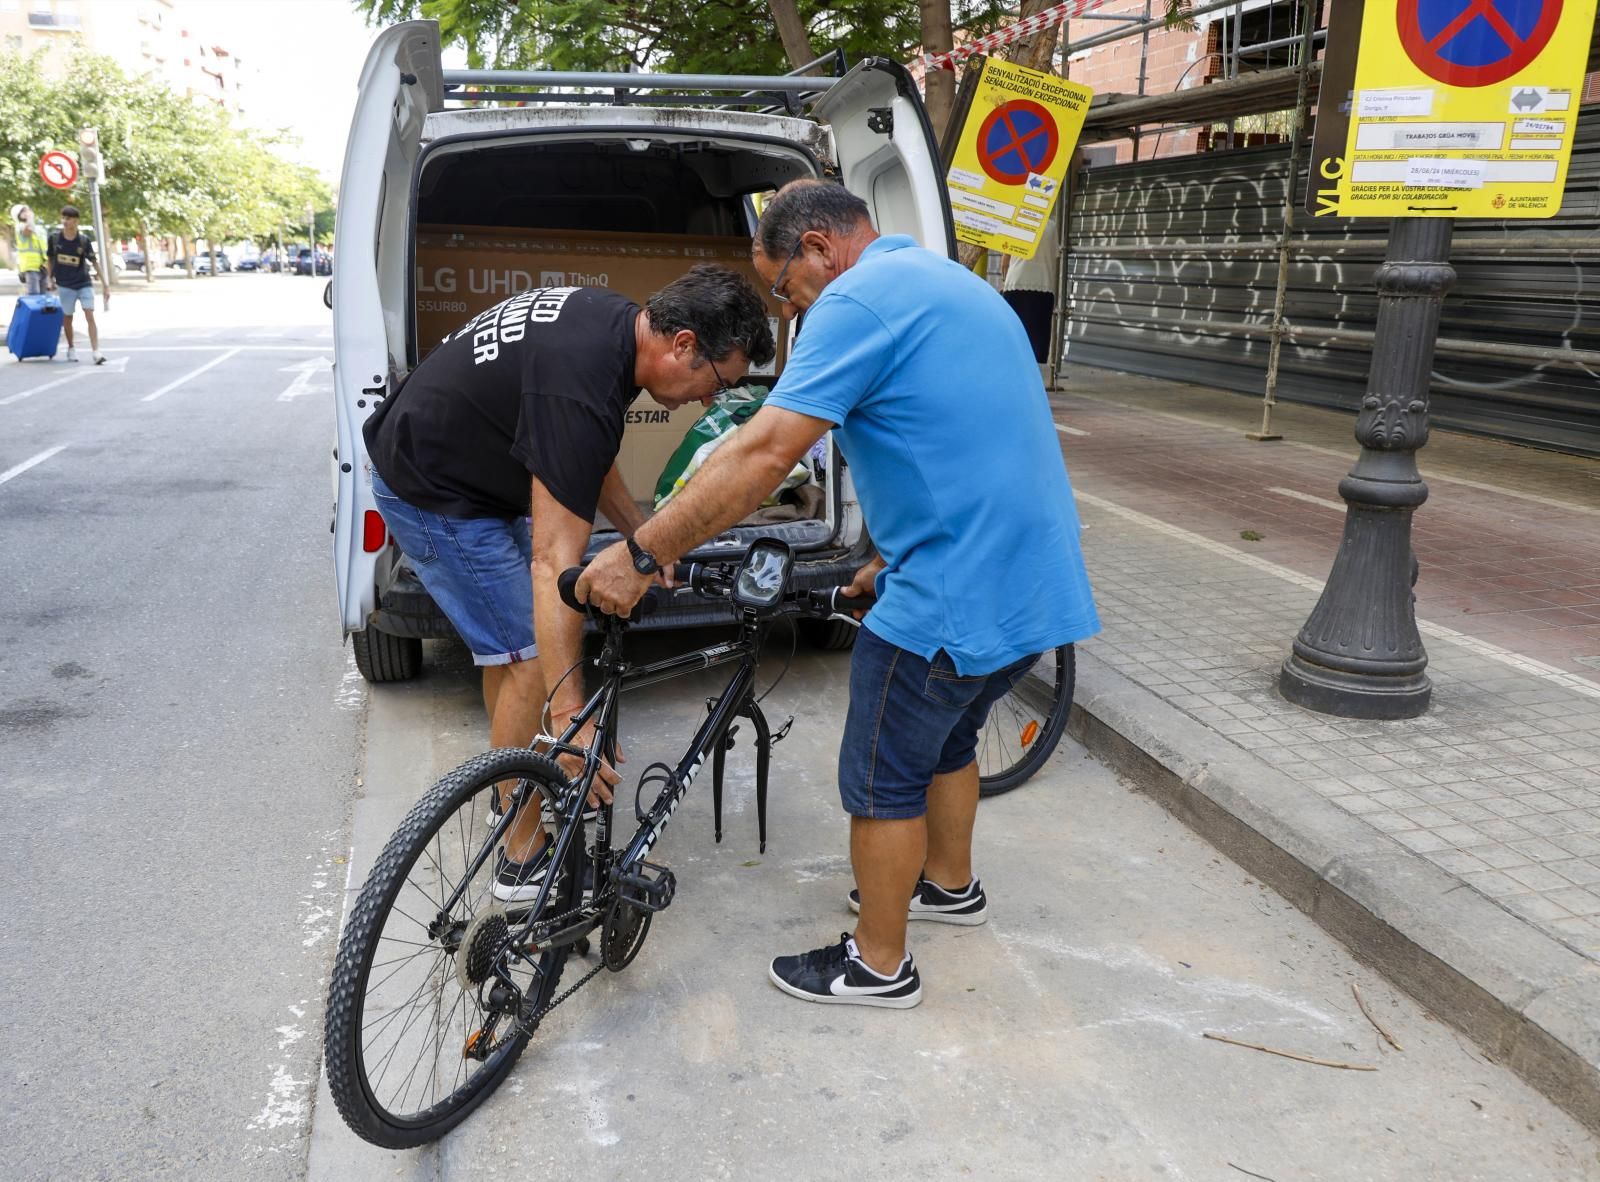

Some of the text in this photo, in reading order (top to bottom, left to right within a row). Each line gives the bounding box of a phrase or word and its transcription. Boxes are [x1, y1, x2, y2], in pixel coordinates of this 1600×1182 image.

[984, 76, 1080, 111] SEÑALIZACIÓN EXCEPCIONAL
[987, 65, 1088, 104] SENYALITZACIÓ EXCEPCIONAL
[1315, 157, 1345, 217] VLC
[417, 267, 457, 293] LG
[468, 269, 533, 295] UHD
[568, 272, 609, 288] ThinQ
[417, 301, 467, 313] 55UR80
